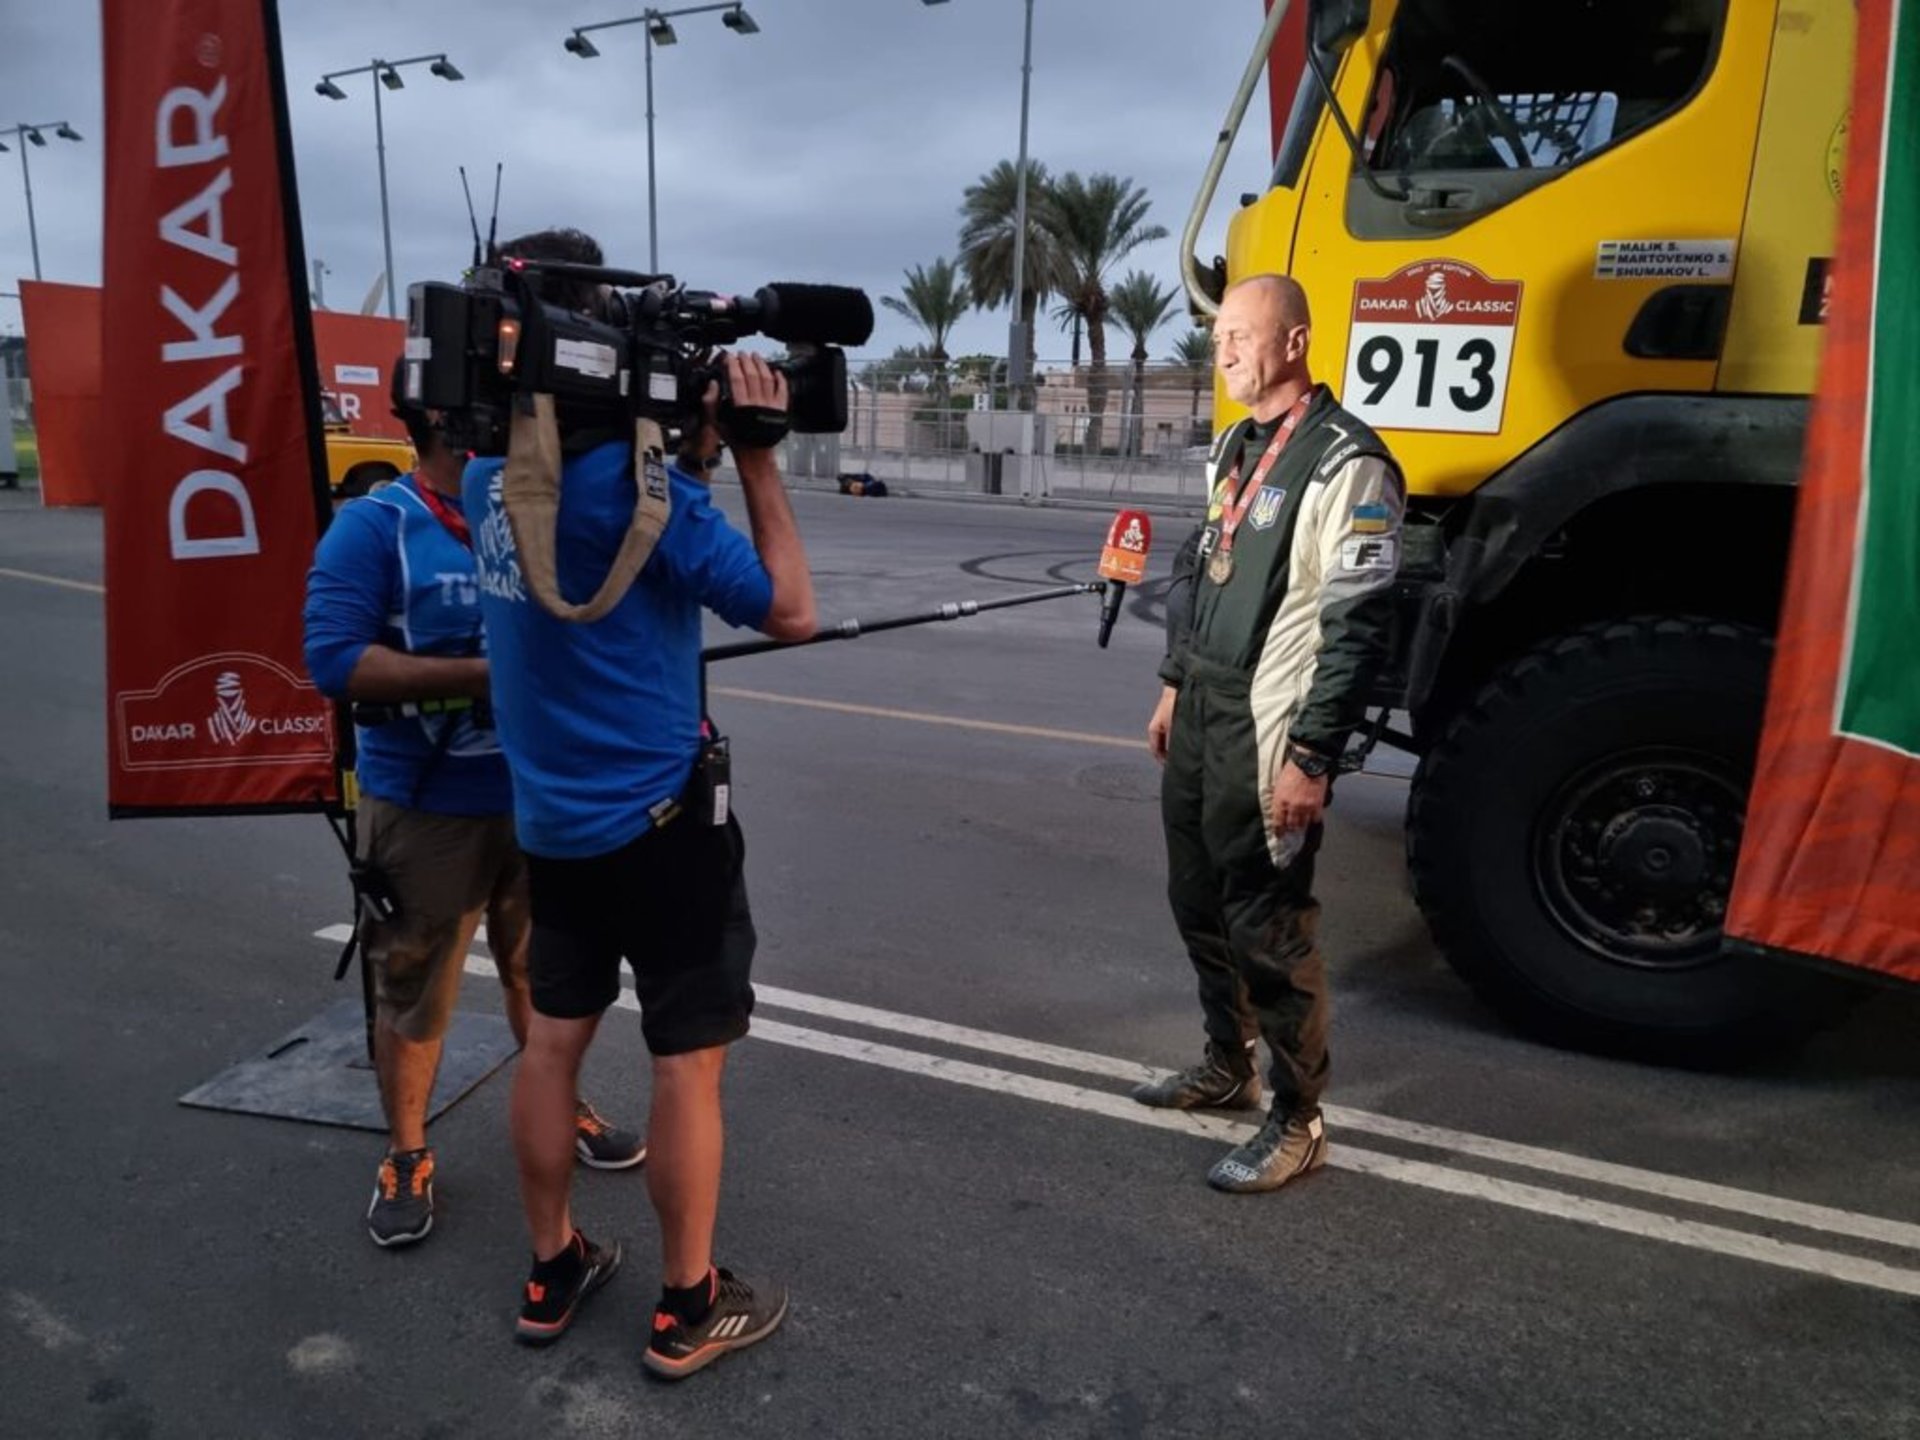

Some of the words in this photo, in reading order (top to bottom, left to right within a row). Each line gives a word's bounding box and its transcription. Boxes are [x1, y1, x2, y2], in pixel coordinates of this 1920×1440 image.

[1620, 242, 1663, 252] MALIK
[1617, 253, 1714, 264] MARTOVENKO
[1616, 267, 1695, 277] SHUMAKOV
[1360, 299, 1408, 311] DAKAR
[1456, 301, 1515, 313] CLASSIC
[155, 75, 261, 560] DAKAR
[1356, 335, 1497, 412] 913
[131, 722, 196, 743] DAKAR
[259, 716, 325, 736] CLASSIC
